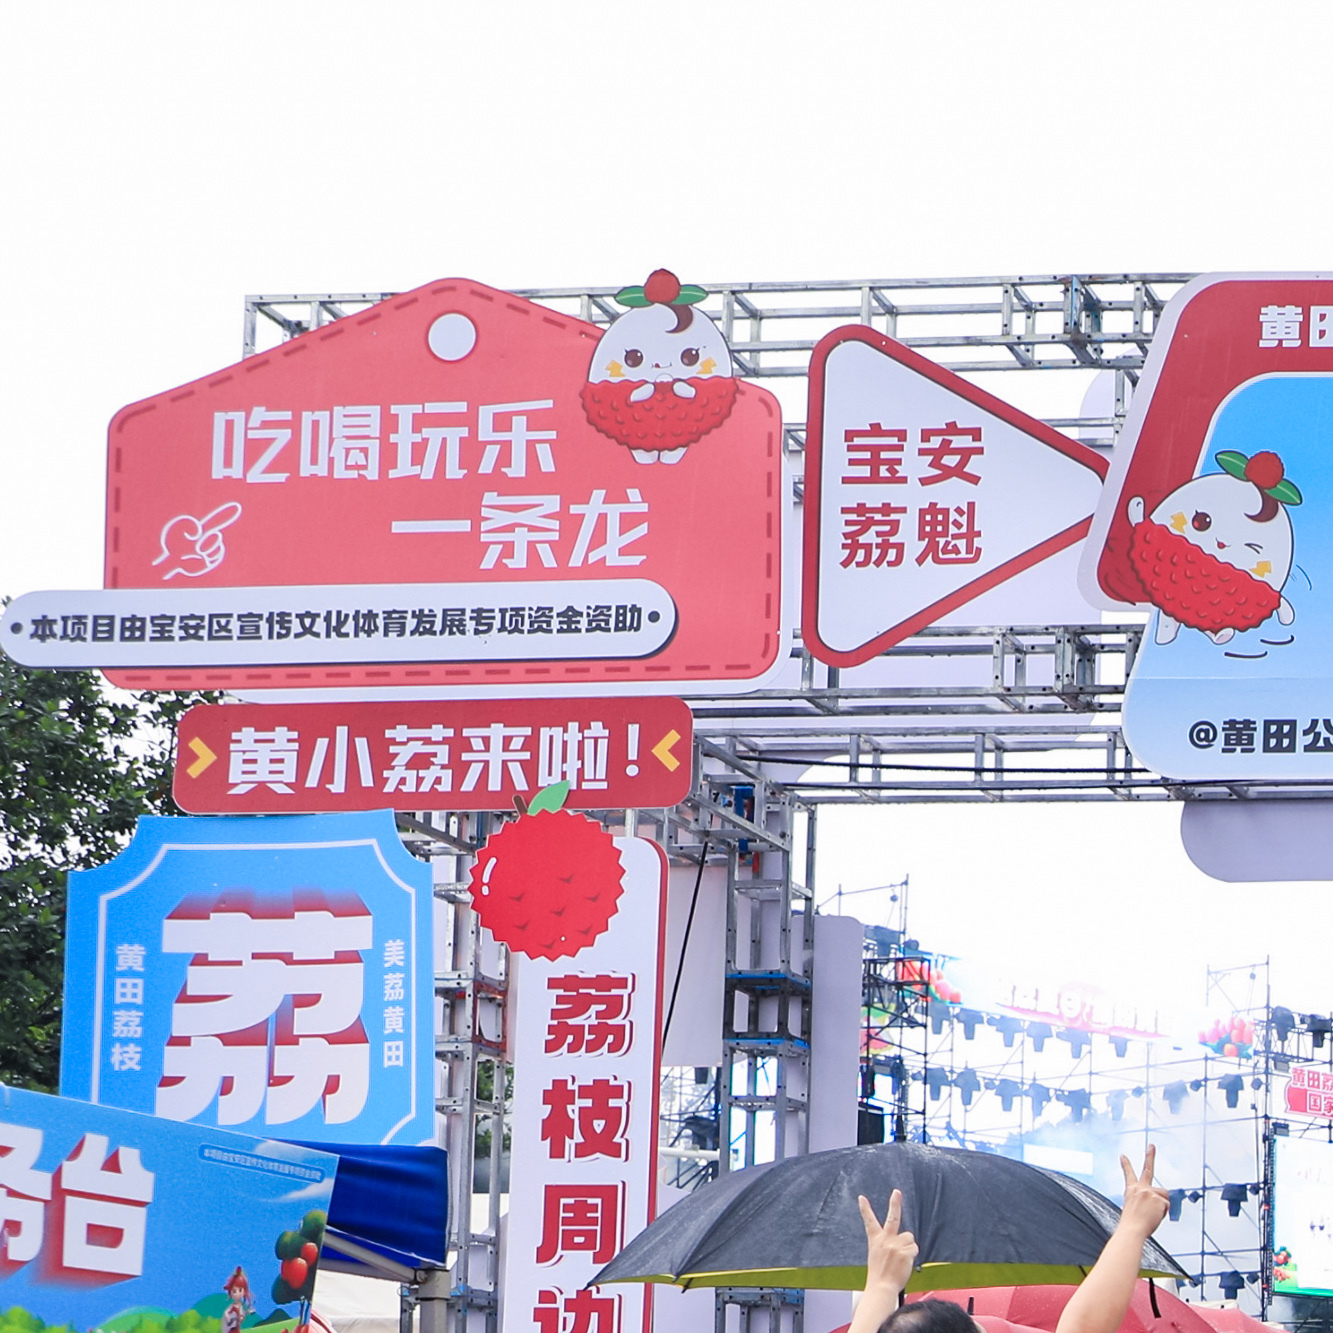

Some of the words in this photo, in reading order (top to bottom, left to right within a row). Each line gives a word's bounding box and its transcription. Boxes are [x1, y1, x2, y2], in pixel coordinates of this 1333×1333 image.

[211, 398, 558, 484] 吃喝玩乐
[840, 420, 984, 487] 宝安
[390, 488, 651, 570] 一条龙
[839, 500, 983, 569] 荔魁
[30, 605, 642, 644] 本项目由宝安区宣传文化体育发展专项资金资助
[111, 943, 146, 1072] 黄田荔枝
[155, 908, 373, 1126] 荔
[382, 938, 405, 1068] 美荔黄田
